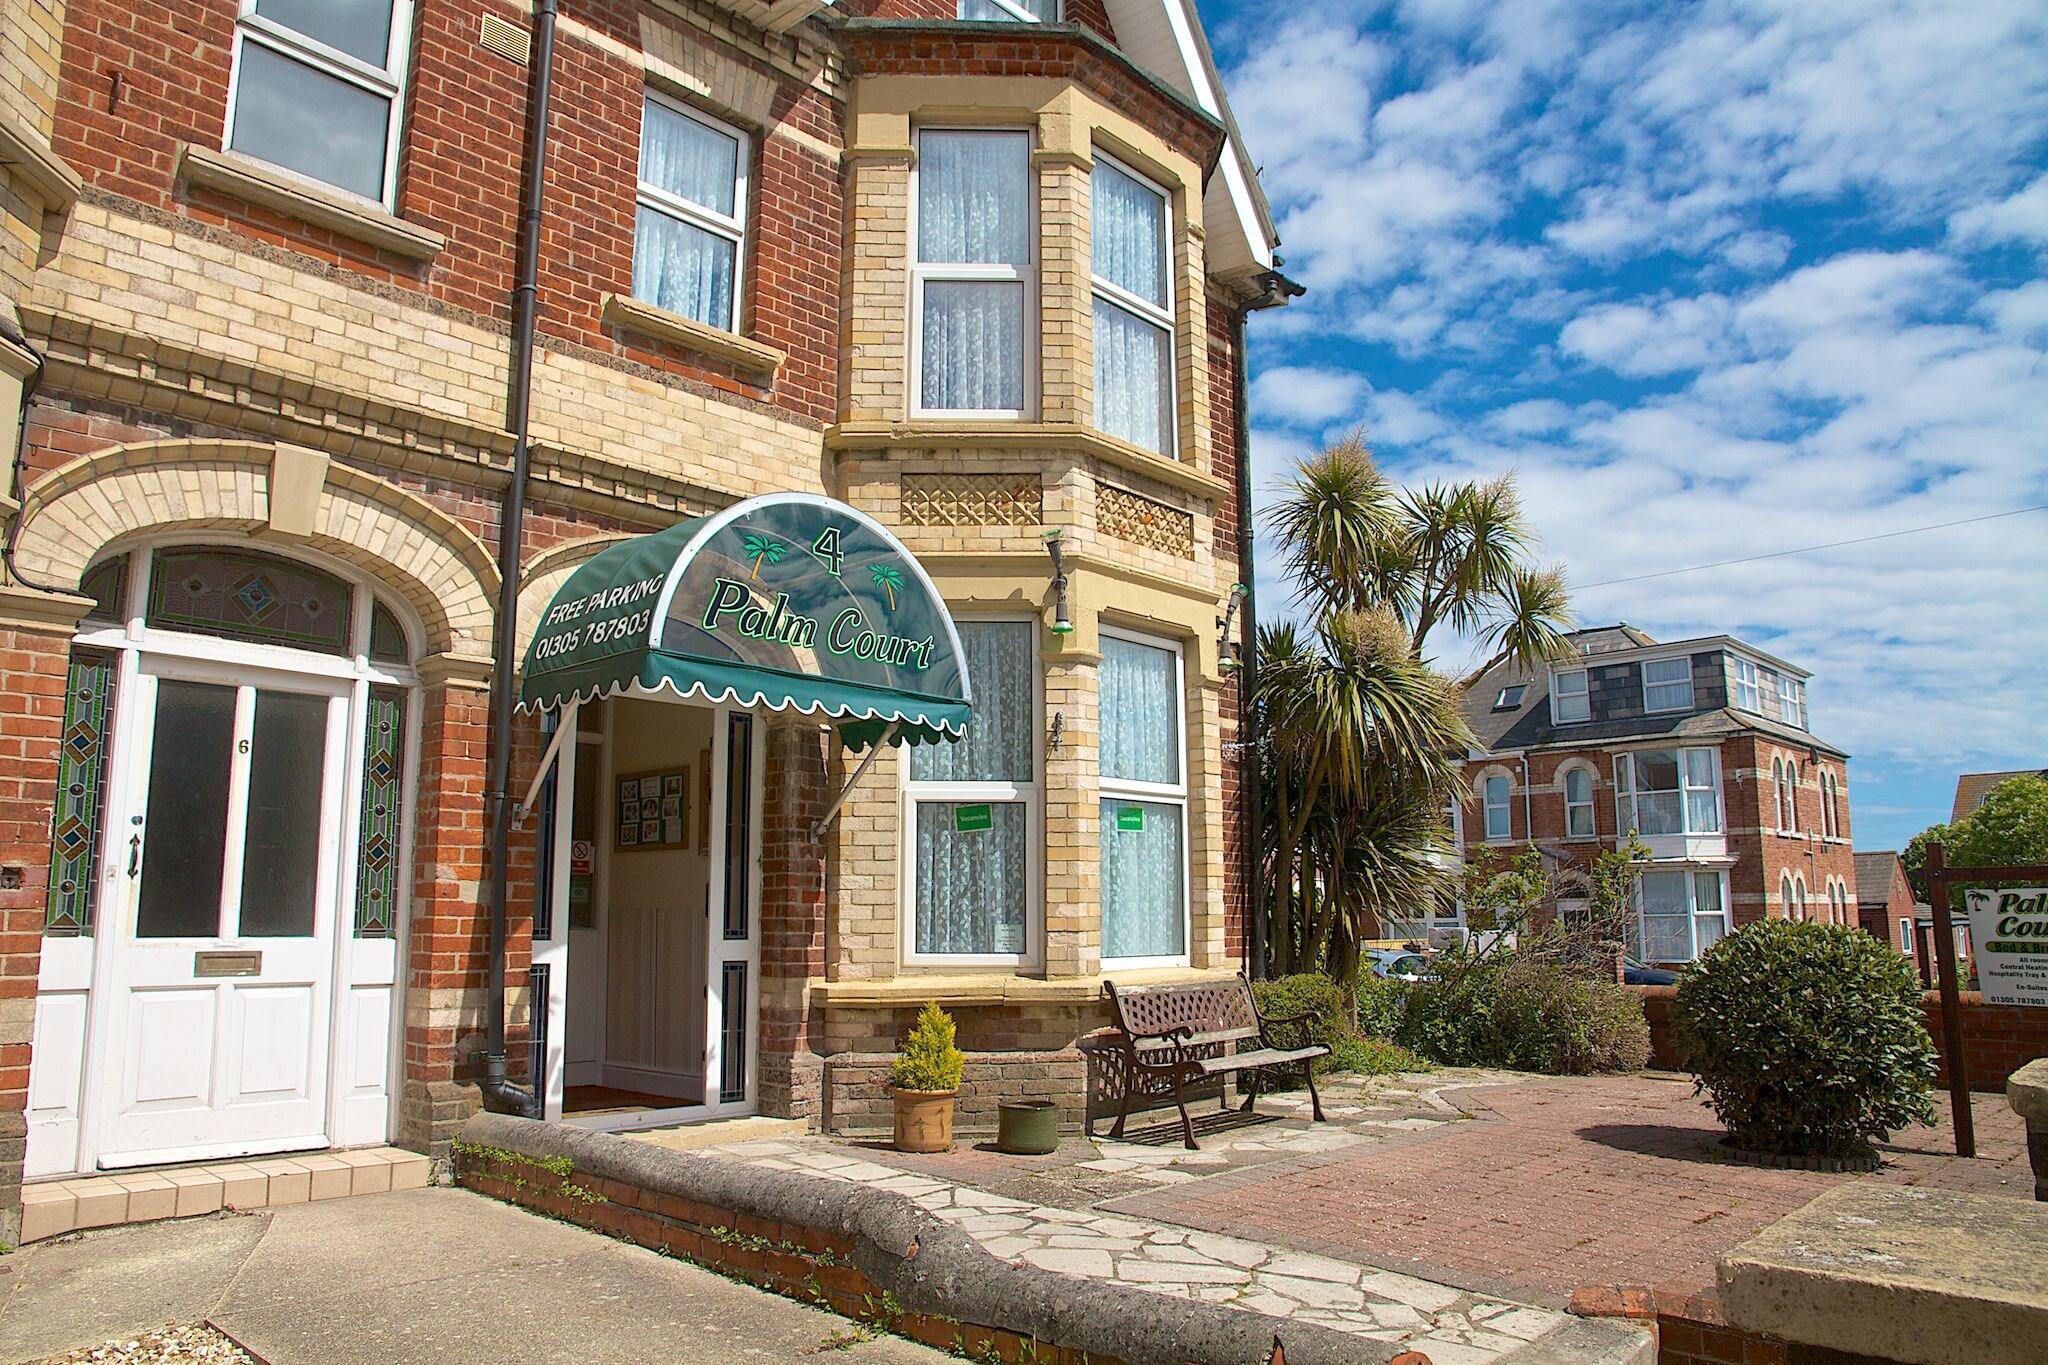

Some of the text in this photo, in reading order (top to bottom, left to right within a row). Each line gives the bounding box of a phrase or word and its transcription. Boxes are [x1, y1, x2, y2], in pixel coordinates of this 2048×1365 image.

[813, 527, 845, 576] 4
[545, 573, 664, 626] FREE PARKING
[535, 609, 651, 660] 01305 787803
[702, 577, 935, 669] Palm Court
[239, 740, 249, 754] 6
[960, 814, 988, 822] Vacancies
[1997, 893, 2048, 915] Pal
[1989, 970, 2023, 978] Hospitality
